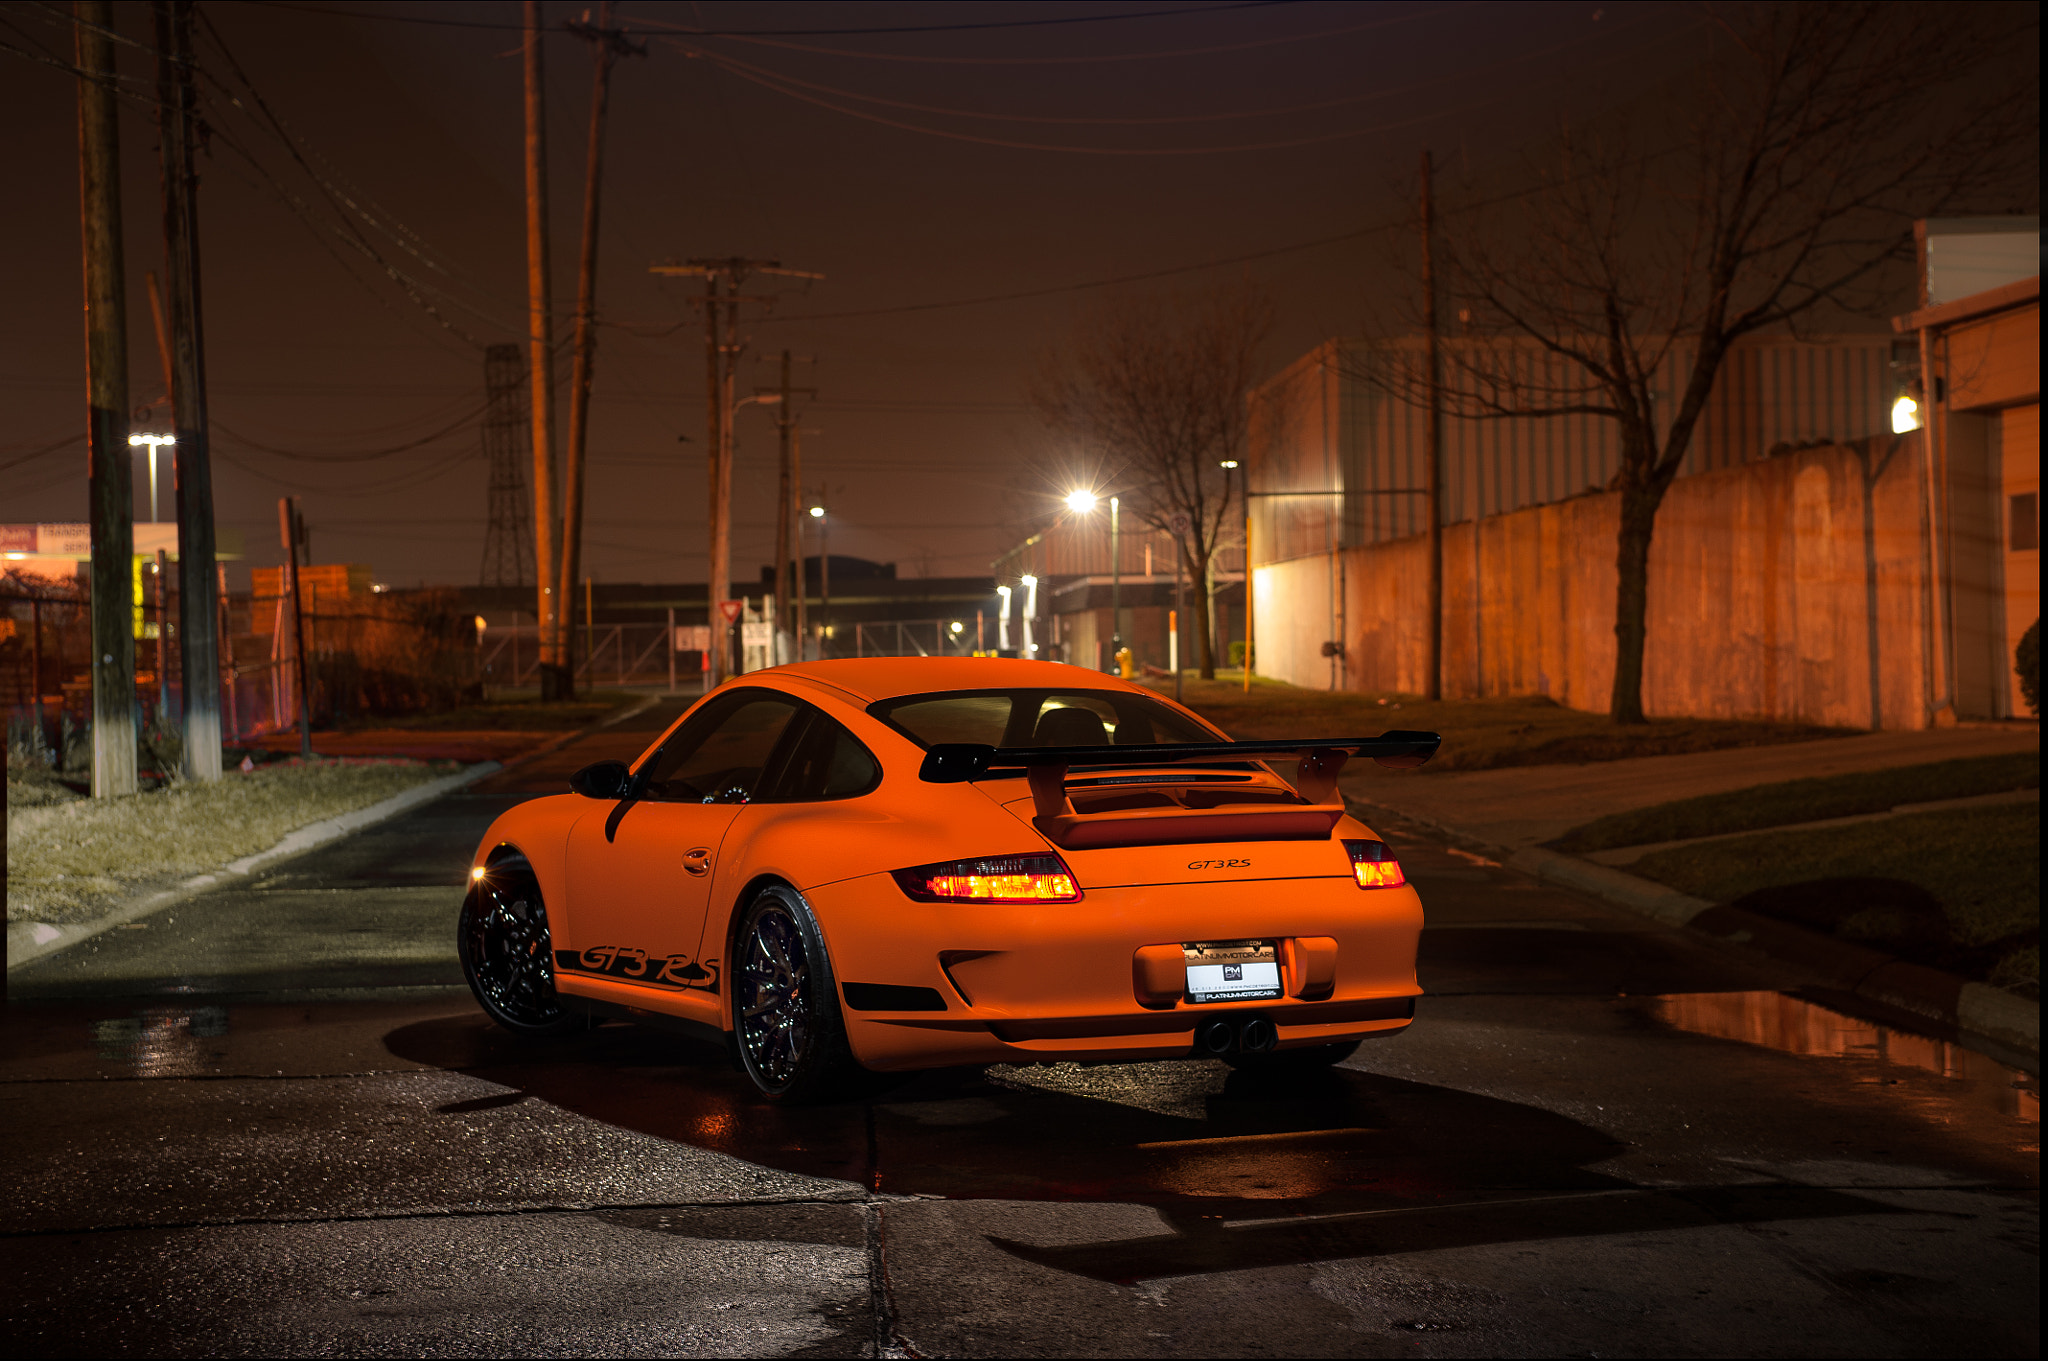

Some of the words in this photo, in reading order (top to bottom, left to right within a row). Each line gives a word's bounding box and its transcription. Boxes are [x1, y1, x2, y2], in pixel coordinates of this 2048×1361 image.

[579, 946, 649, 976] GT3
[656, 954, 720, 987] RS
[1206, 991, 1277, 1000] PLATINUMMOTORCARS
